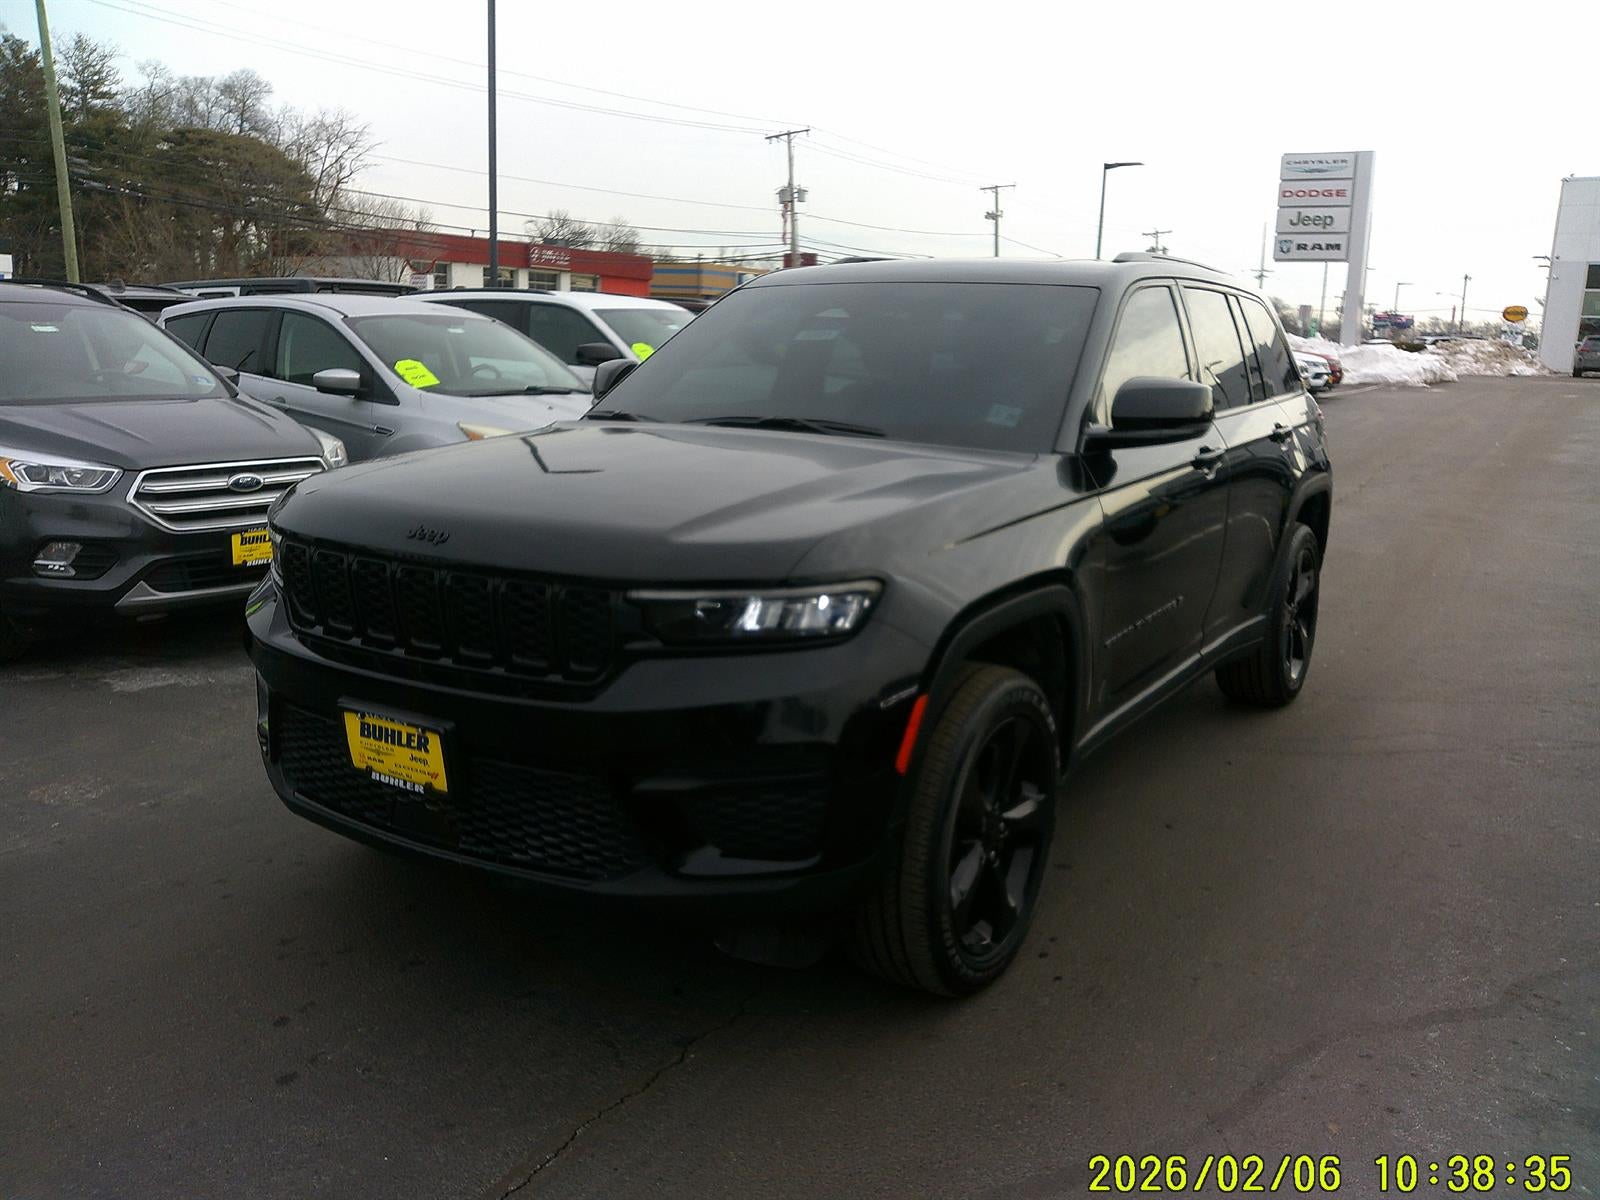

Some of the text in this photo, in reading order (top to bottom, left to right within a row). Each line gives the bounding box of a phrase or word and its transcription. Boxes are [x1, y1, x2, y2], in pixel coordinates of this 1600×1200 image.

[1281, 189, 1347, 198] DODGE
[1289, 211, 1334, 229] Jeep
[1296, 243, 1342, 251] RAM
[240, 533, 272, 546] BUHL
[406, 523, 450, 546] Jeep
[359, 720, 430, 754] BUHLER
[371, 770, 425, 794] BUHLER
